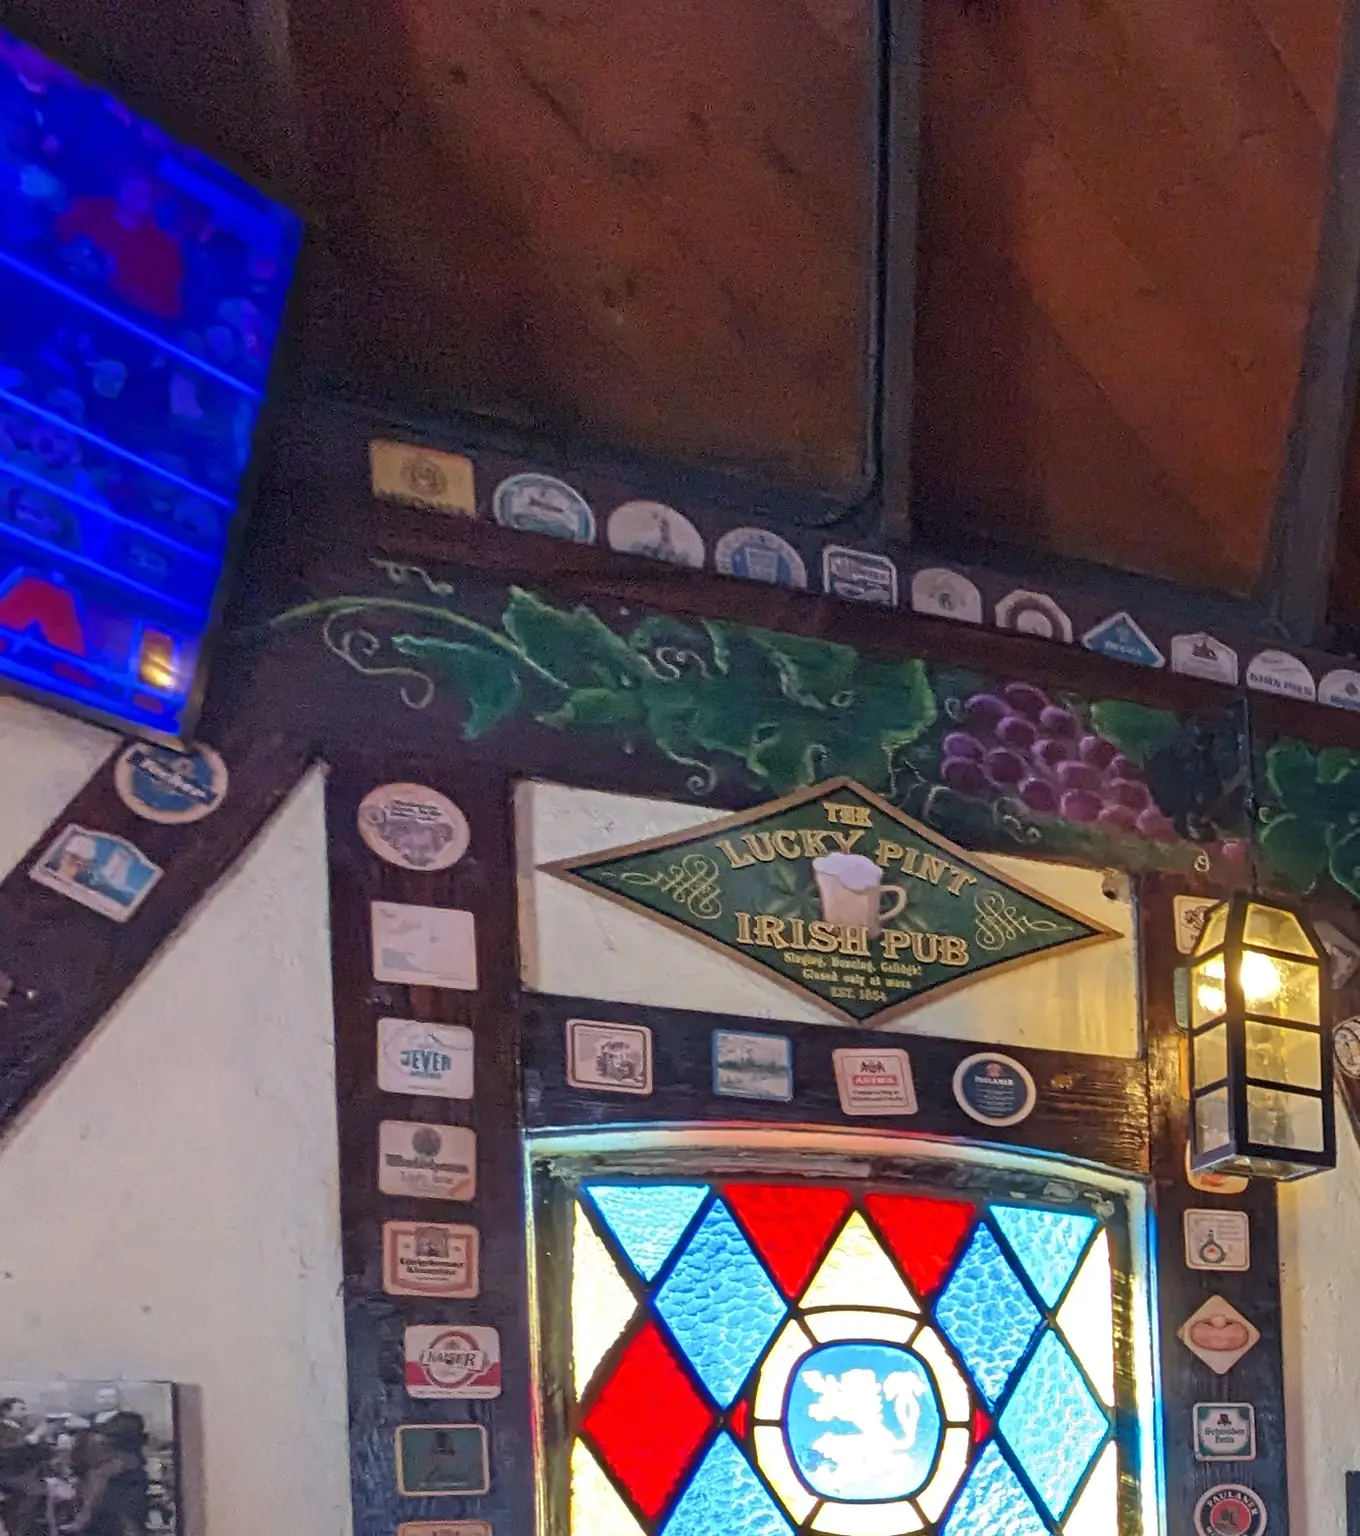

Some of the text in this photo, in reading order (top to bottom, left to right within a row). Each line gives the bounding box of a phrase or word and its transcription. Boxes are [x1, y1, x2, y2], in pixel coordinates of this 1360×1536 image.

[823, 802, 873, 828] THE
[715, 830, 977, 896] LUCKY PINT
[735, 912, 970, 967] IRISH PUB
[400, 1049, 452, 1072] JEVER
[1206, 1490, 1259, 1516] PAULANER
